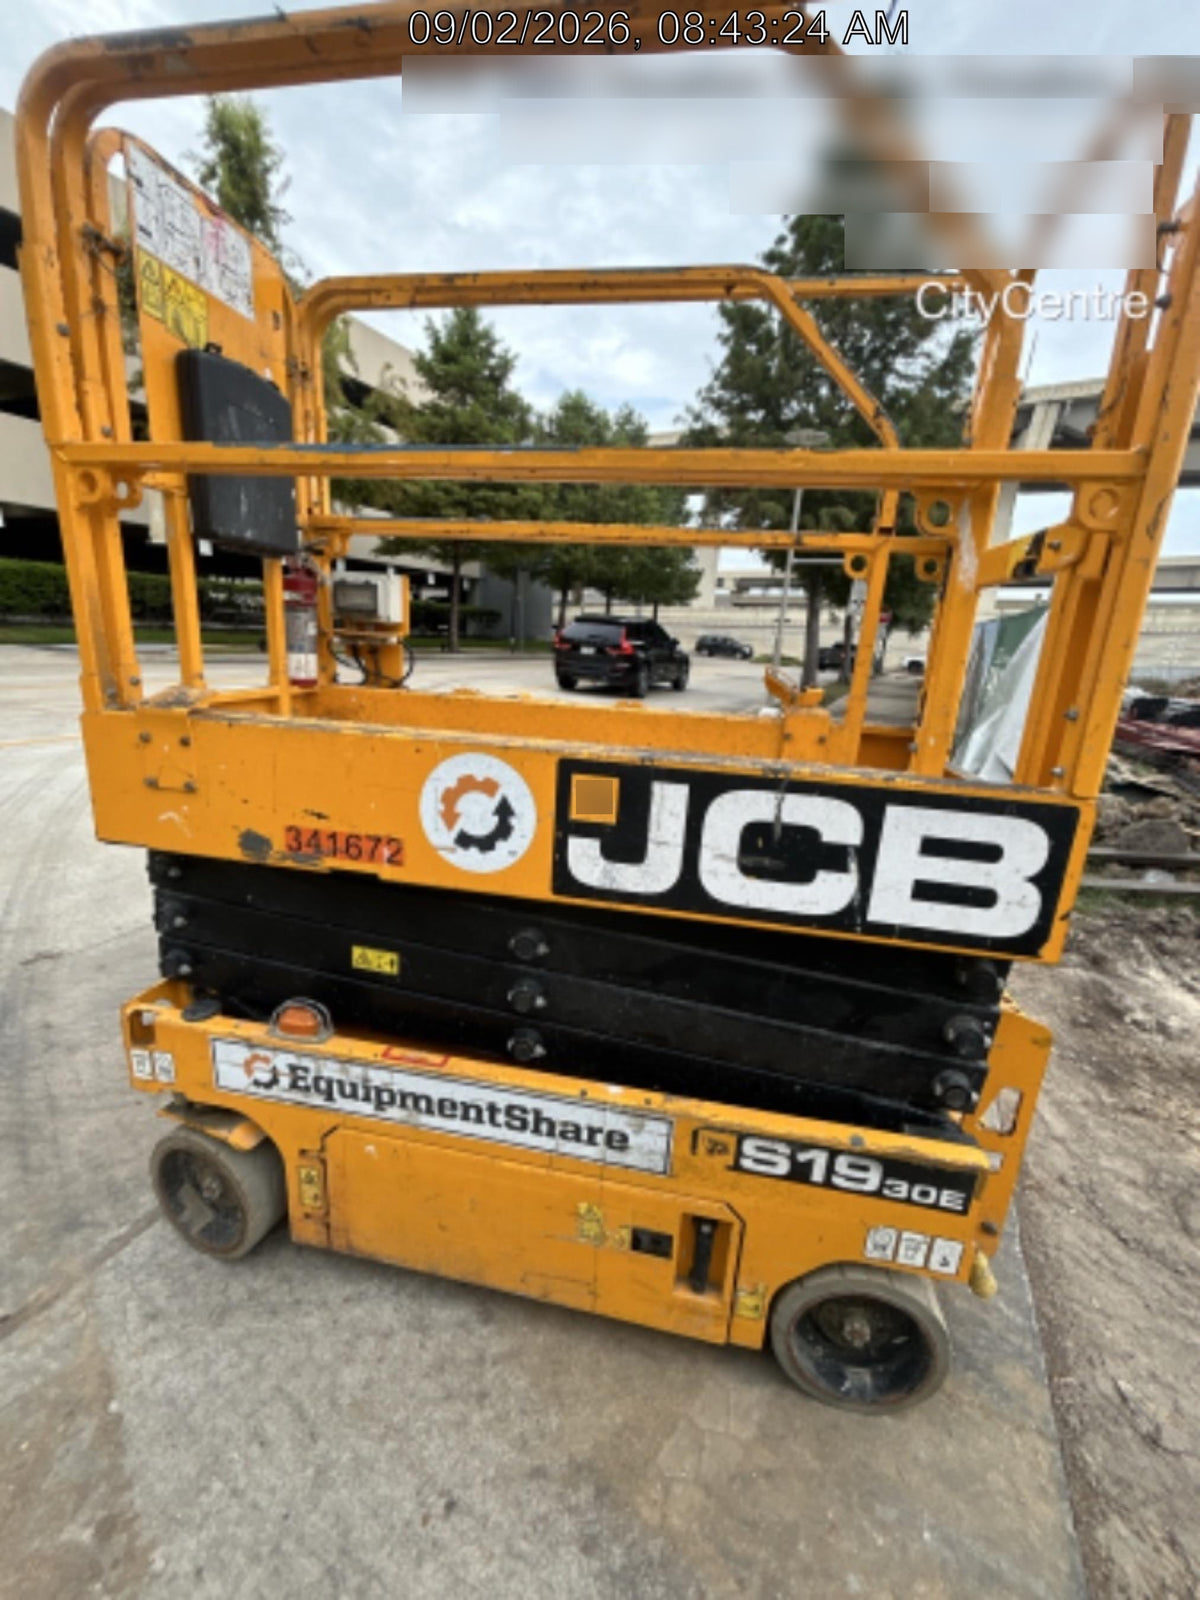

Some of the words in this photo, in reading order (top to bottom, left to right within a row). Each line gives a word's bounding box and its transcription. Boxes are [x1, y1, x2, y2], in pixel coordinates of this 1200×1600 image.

[284, 824, 404, 867] 341672
[567, 780, 1049, 938] JCB
[286, 1063, 629, 1152] EquipmentShare
